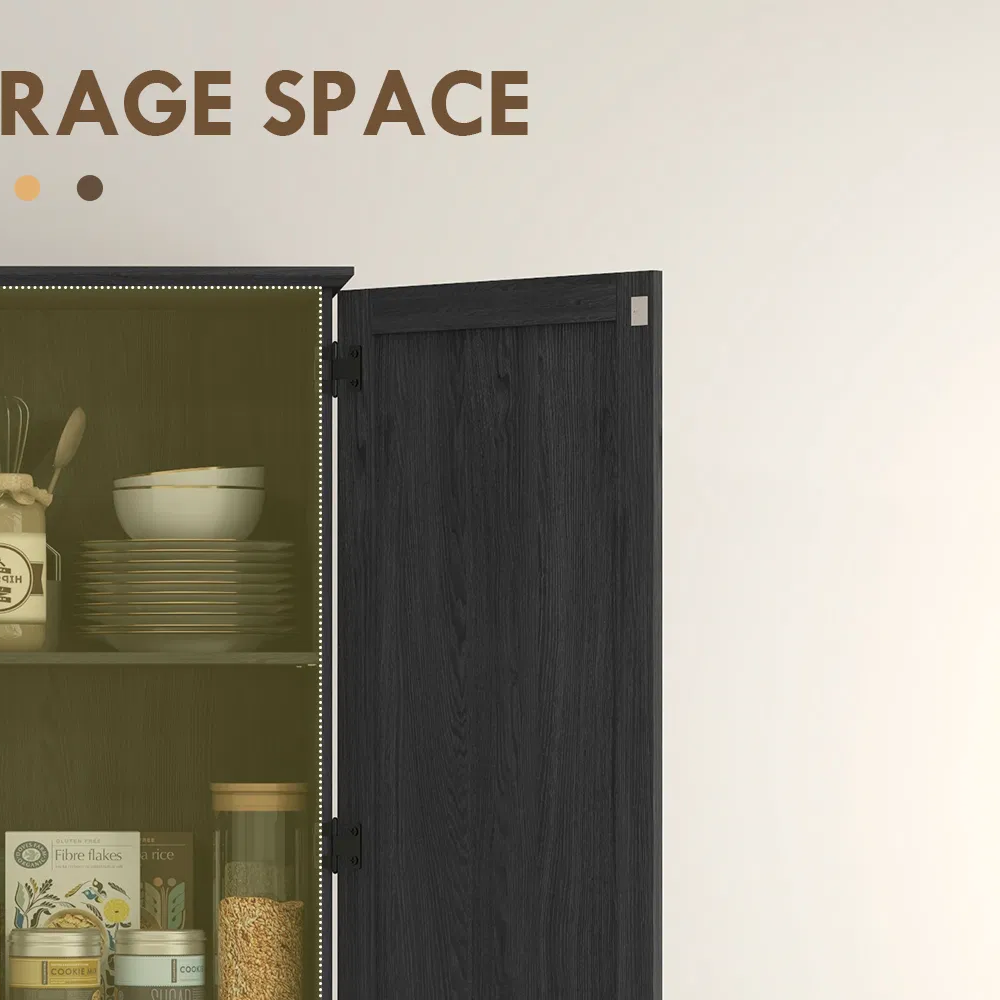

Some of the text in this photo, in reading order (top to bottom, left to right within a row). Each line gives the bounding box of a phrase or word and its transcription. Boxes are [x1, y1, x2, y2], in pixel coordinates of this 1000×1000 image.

[55, 848, 123, 861] Fibre flakes
[151, 848, 175, 861] rice
[50, 968, 85, 976] COOKIE
